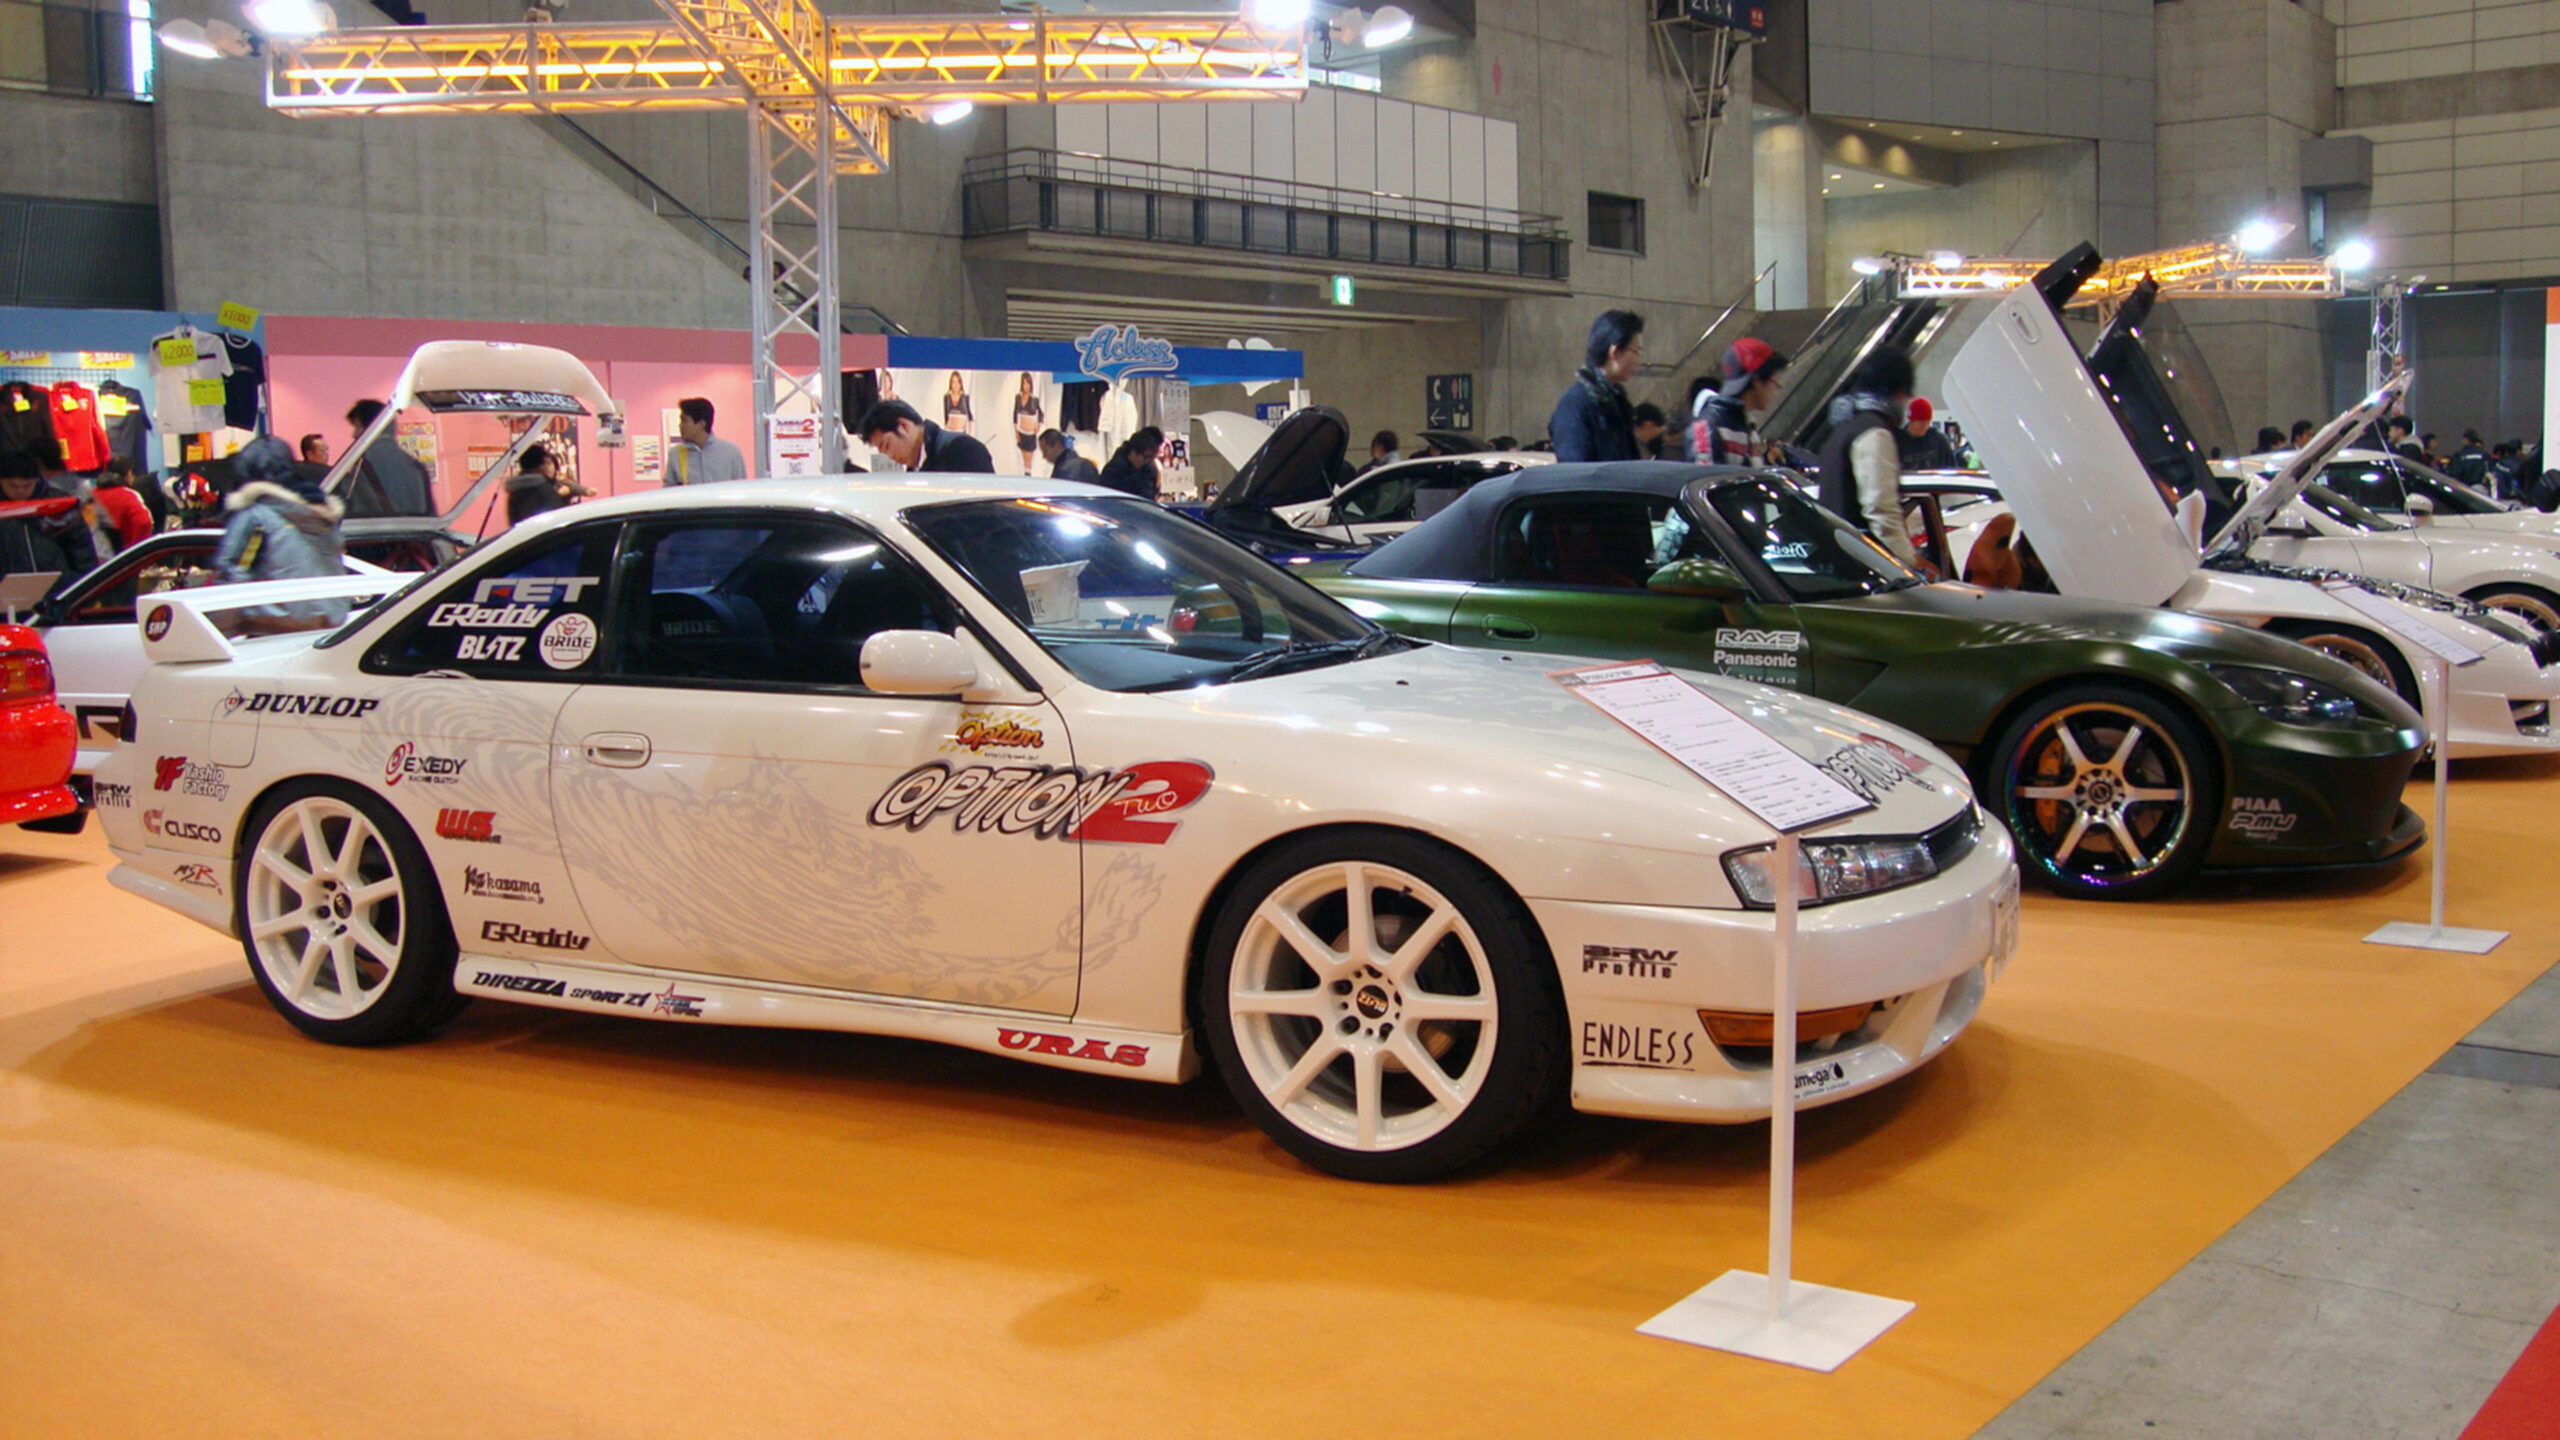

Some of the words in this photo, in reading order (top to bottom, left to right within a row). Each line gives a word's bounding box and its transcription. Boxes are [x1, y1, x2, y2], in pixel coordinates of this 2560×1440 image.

[1076, 325, 1174, 371] Aclass
[456, 634, 527, 661] BLITZ
[543, 635, 593, 650] BRIDE
[1716, 628, 1800, 646] RAYS
[1713, 649, 1797, 668] Panasonic
[245, 693, 379, 718] DUNLOP
[956, 720, 1044, 752] Option
[184, 762, 226, 784] Yashio
[403, 756, 467, 775] EXEDY
[182, 779, 229, 801] Factory
[867, 760, 1137, 841] OPTION
[1066, 760, 1215, 846] 2
[2231, 796, 2282, 811] PIAA
[164, 820, 222, 843] CUSCO
[481, 921, 590, 950] GReddy
[1583, 959, 1672, 979] Profile
[472, 971, 567, 998] DIREZZA
[570, 987, 626, 1005] SPORT
[623, 991, 652, 1008] Z1
[997, 1027, 1150, 1067] URAS
[1582, 1022, 1694, 1066] ENDLESS
